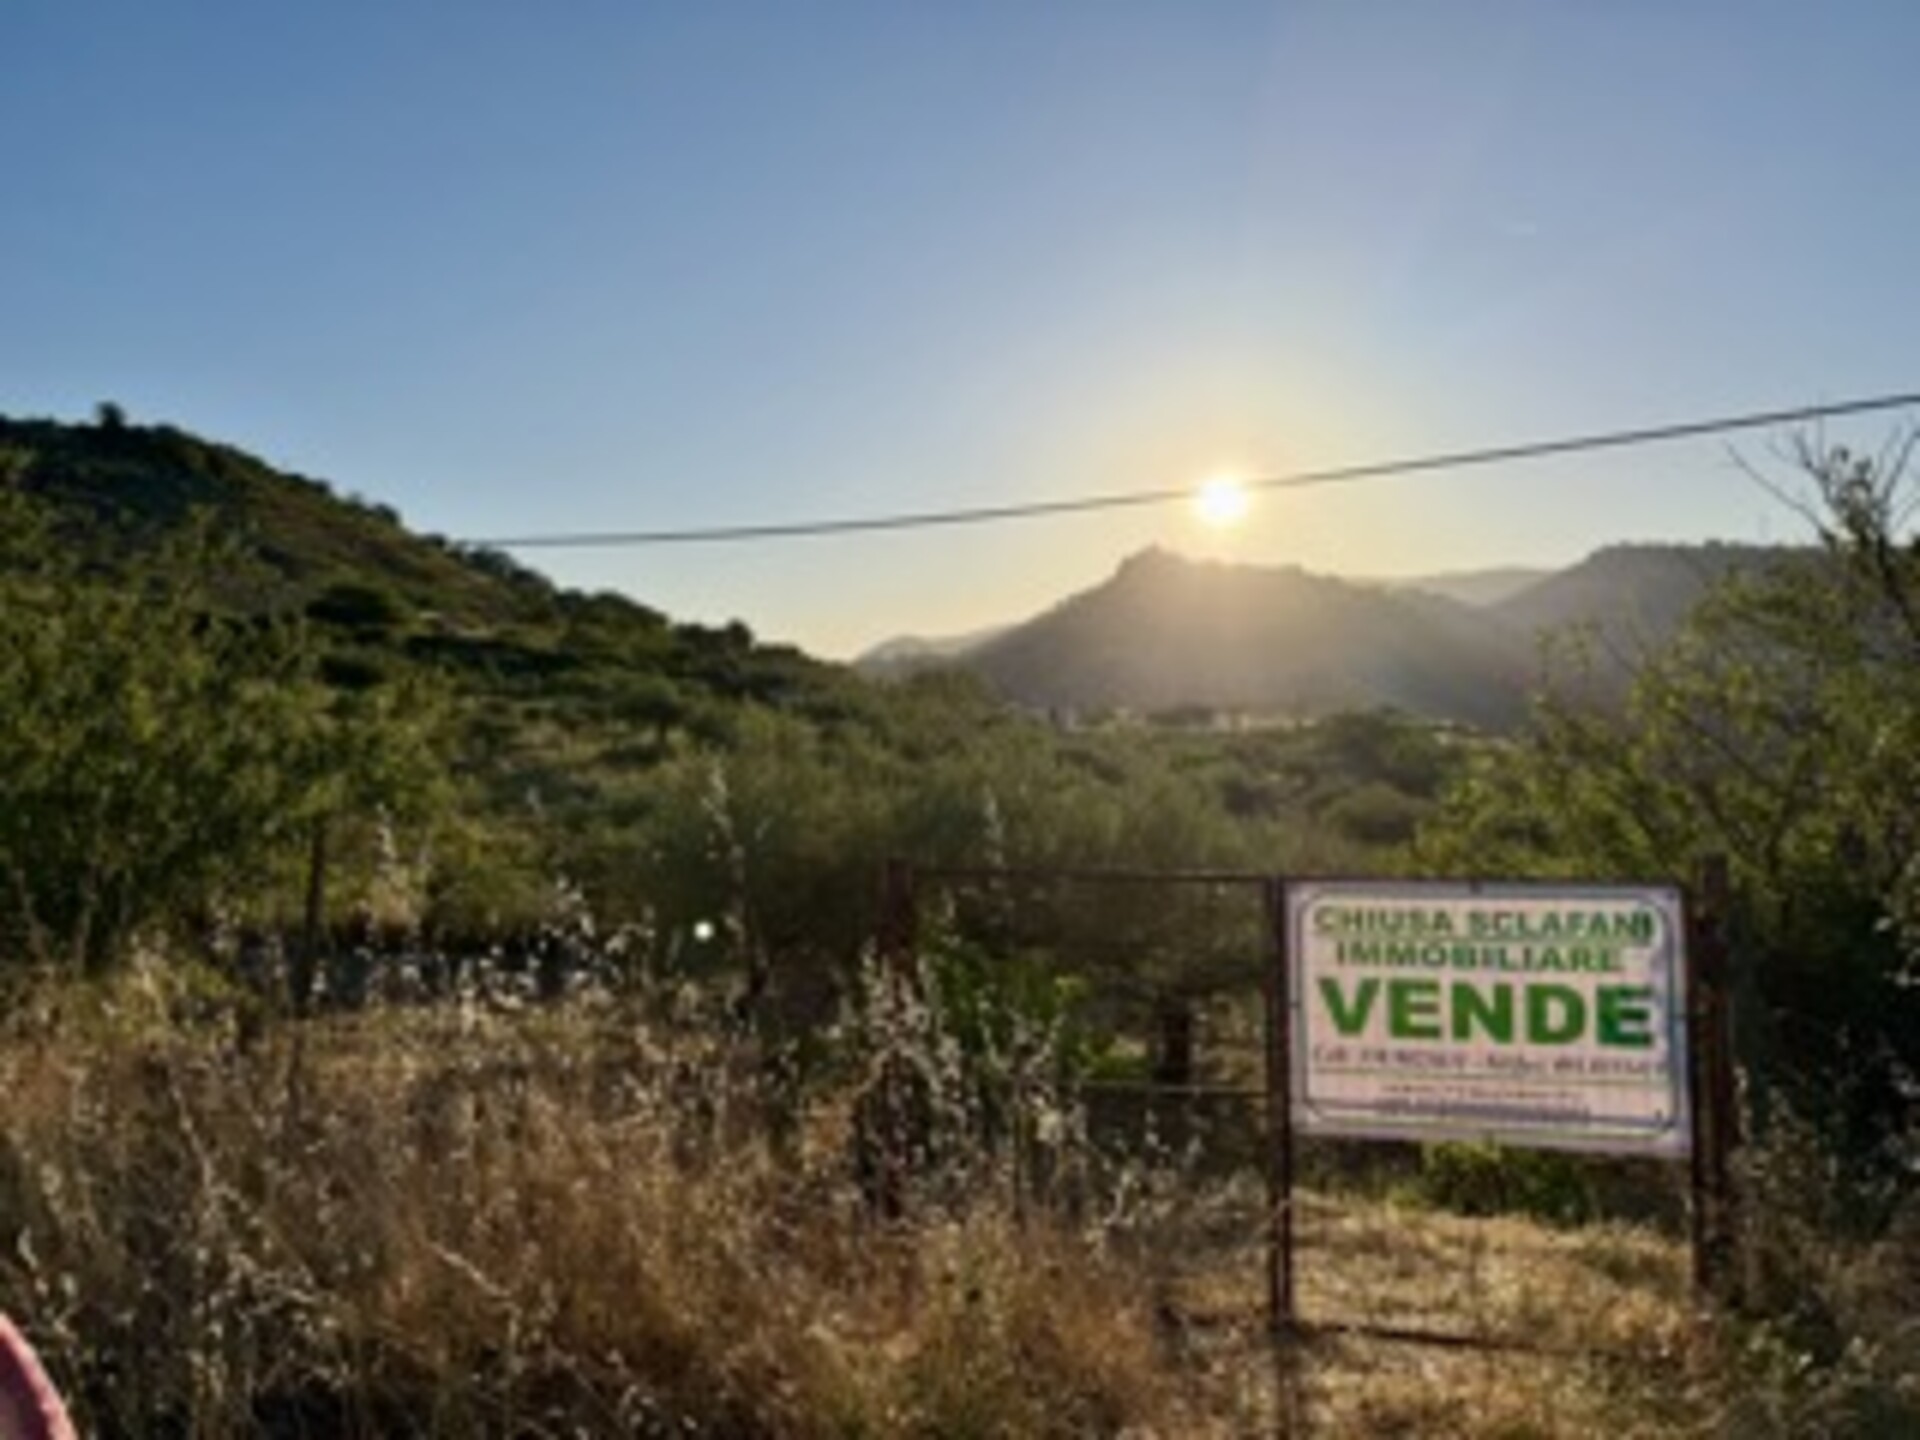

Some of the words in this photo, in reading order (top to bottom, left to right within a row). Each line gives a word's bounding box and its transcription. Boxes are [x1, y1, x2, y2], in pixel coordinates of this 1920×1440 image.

[1314, 906, 1453, 935] CHIUSA
[1468, 909, 1654, 943] SCLAFANI
[1337, 940, 1623, 972] IMMOBILIARE
[1317, 977, 1654, 1048] VENDE
